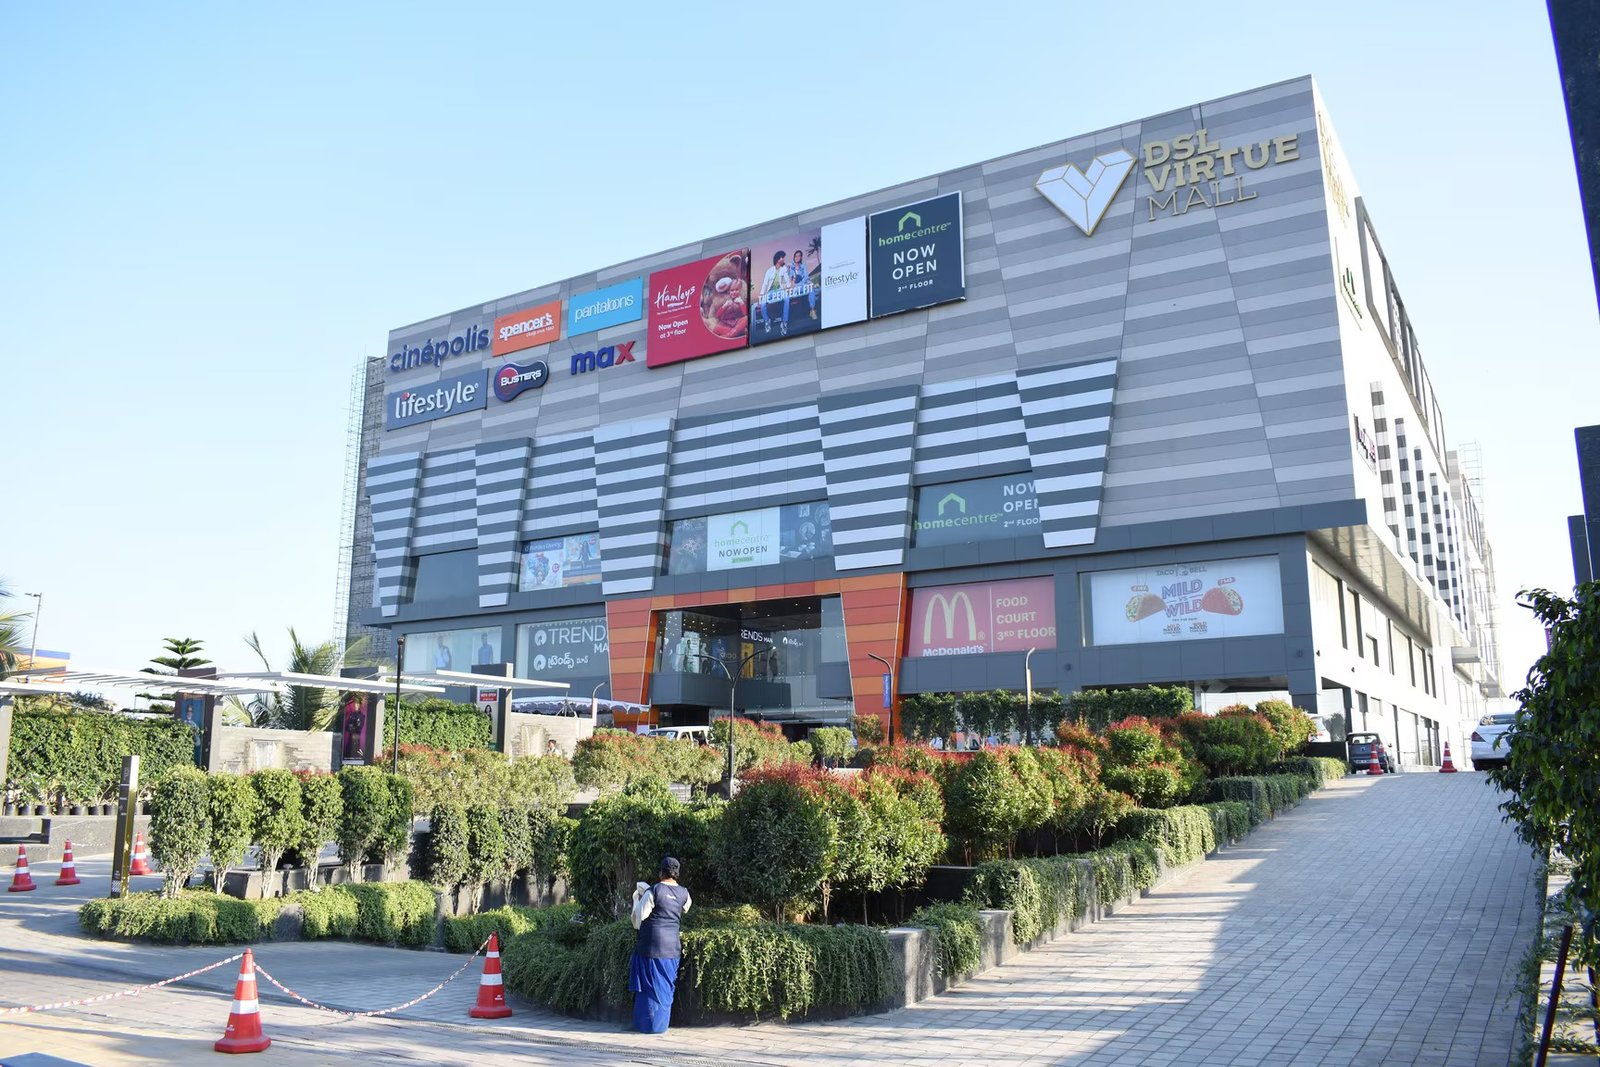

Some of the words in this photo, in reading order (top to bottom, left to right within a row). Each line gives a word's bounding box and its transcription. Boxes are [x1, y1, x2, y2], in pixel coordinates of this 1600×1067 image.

[1143, 128, 1220, 168] DSL
[1144, 133, 1300, 192] VIRTUE
[1146, 175, 1258, 221] MALL
[893, 243, 936, 265] NOW
[892, 259, 937, 280] OPEN
[758, 293, 771, 304] THE
[772, 285, 802, 301] PERFECT
[803, 283, 814, 294] FIT
[910, 280, 934, 290] FLOOR
[654, 284, 696, 308] Hamleys
[574, 294, 634, 323] pantaloons
[672, 320, 688, 328] Open
[390, 324, 491, 372] cinépolis
[570, 340, 636, 376] max
[395, 381, 476, 419] lifestyle
[1016, 517, 1042, 526] FLOO
[714, 534, 768, 548] homecentre
[718, 548, 742, 558] NOW
[742, 546, 768, 554] OPEN
[1162, 578, 1203, 600] MILD
[996, 596, 1028, 608] FOOD
[1164, 599, 1202, 618] WILD
[996, 612, 1036, 624] COURT
[548, 624, 608, 644] TREND
[997, 631, 1015, 640] 3RD
[1018, 626, 1056, 639] FLOOR
[594, 642, 608, 654] MA
[922, 644, 984, 657] McDonald's
